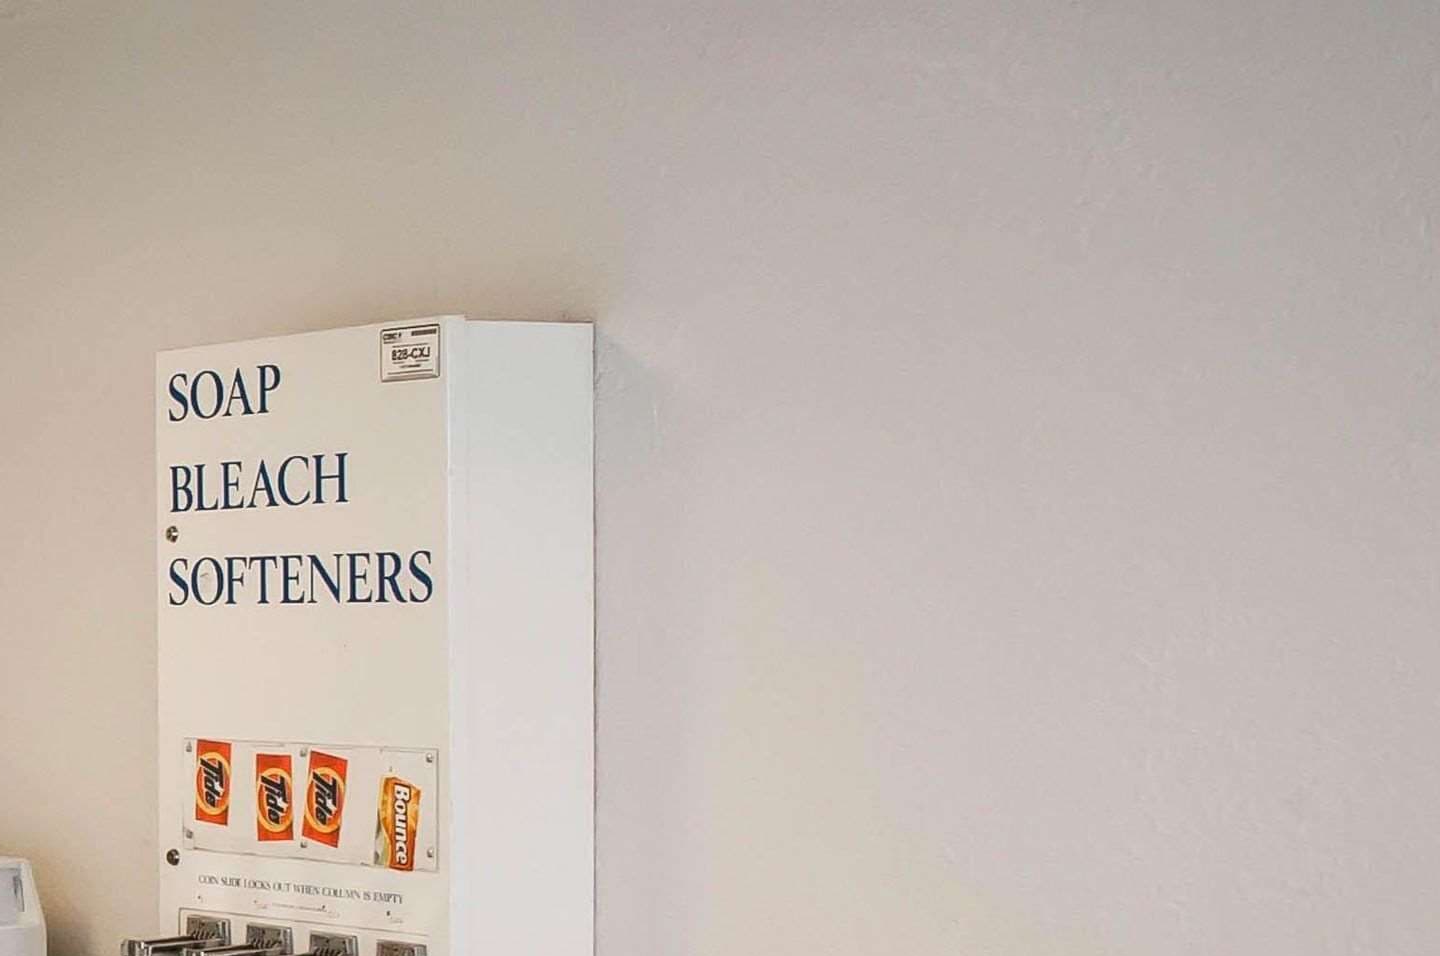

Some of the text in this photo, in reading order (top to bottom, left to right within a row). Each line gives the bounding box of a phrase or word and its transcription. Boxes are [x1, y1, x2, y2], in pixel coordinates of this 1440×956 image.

[168, 364, 281, 422] SOAP
[170, 452, 348, 512] BLEACH
[169, 550, 433, 606] SOFTENERS
[394, 784, 410, 865] Bounce
